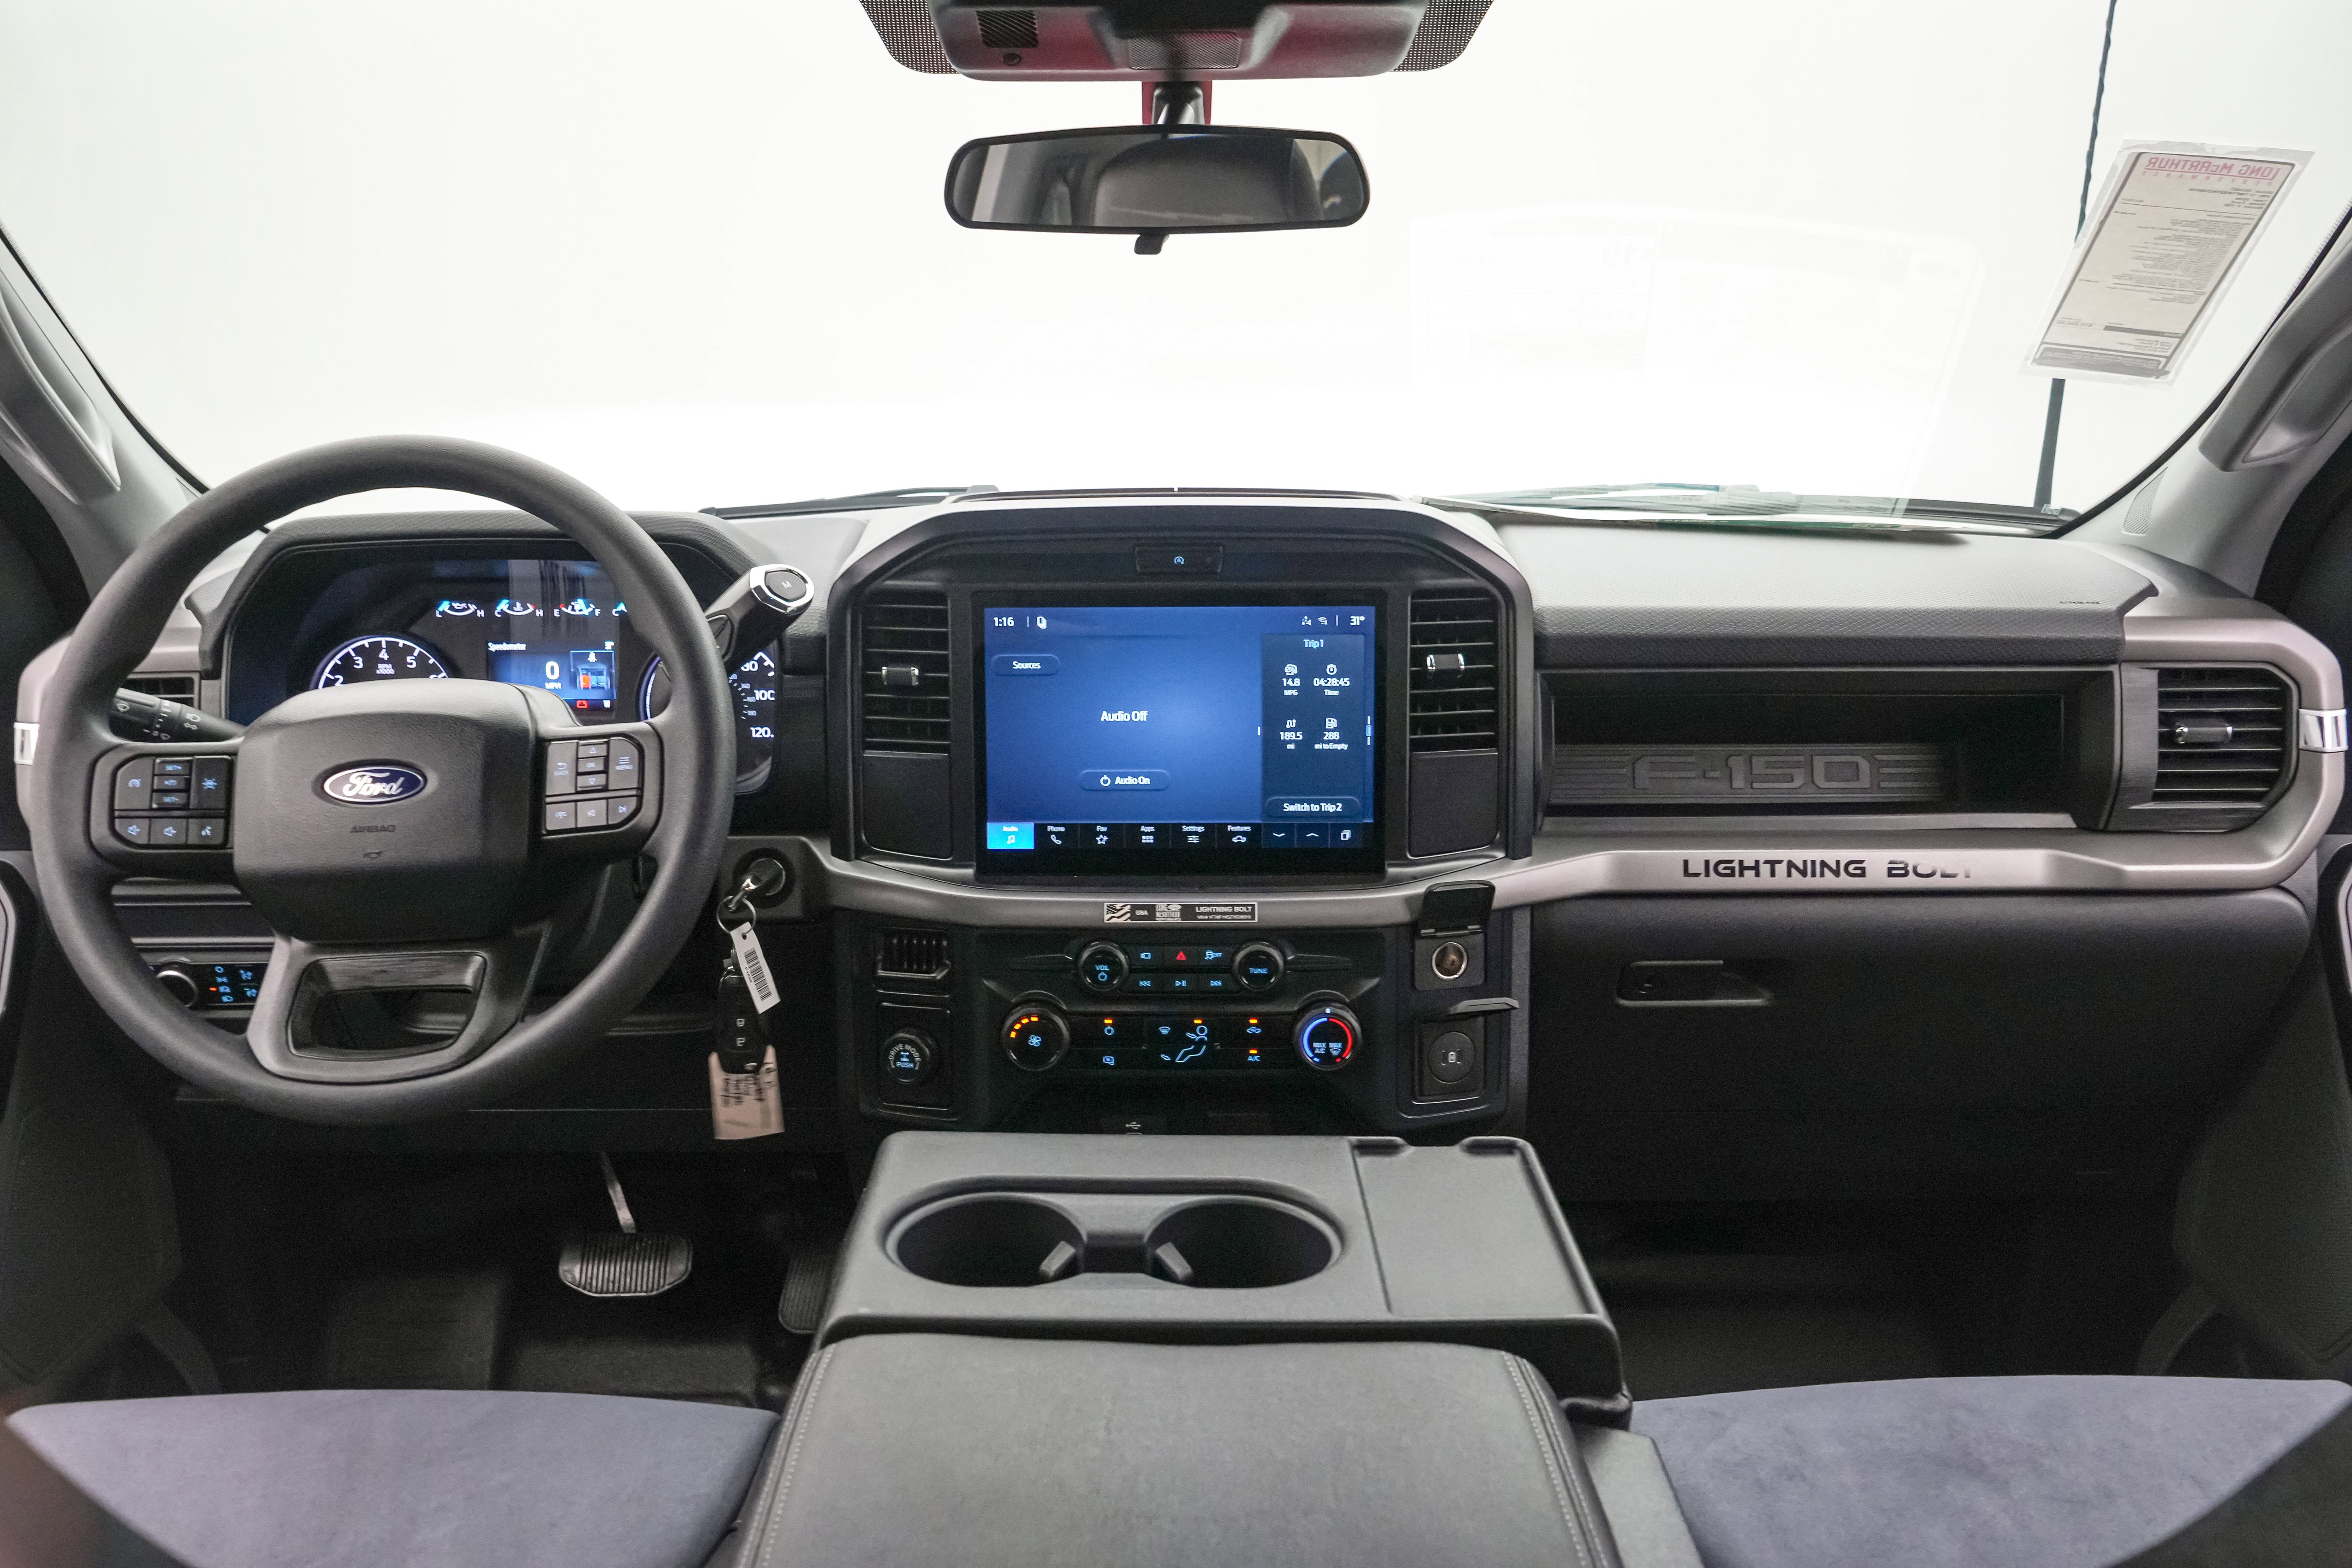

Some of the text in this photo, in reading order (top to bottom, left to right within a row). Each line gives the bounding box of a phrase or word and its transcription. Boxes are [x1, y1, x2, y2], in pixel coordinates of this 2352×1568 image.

[993, 617, 1014, 627] 1:16
[488, 642, 527, 652] Speedometer
[1303, 639, 1319, 649] Trip
[379, 648, 389, 660] 4
[353, 657, 363, 669] 3
[406, 656, 416, 668] 5
[1012, 661, 1041, 669] Sources
[545, 661, 560, 679] 0
[1282, 678, 1301, 686] 14.8
[1313, 677, 1350, 686] 04:28:45
[1100, 710, 1148, 722] Audio Off
[750, 727, 771, 738] 120
[1279, 731, 1303, 740] 189.5
[1323, 731, 1340, 740] 288
[1634, 754, 1871, 790] F-150
[343, 771, 405, 797] Ford
[1114, 776, 1150, 785] Audio On
[1283, 803, 1343, 813] Switch to Trip 2
[1683, 859, 1867, 879] LIGHTNING
